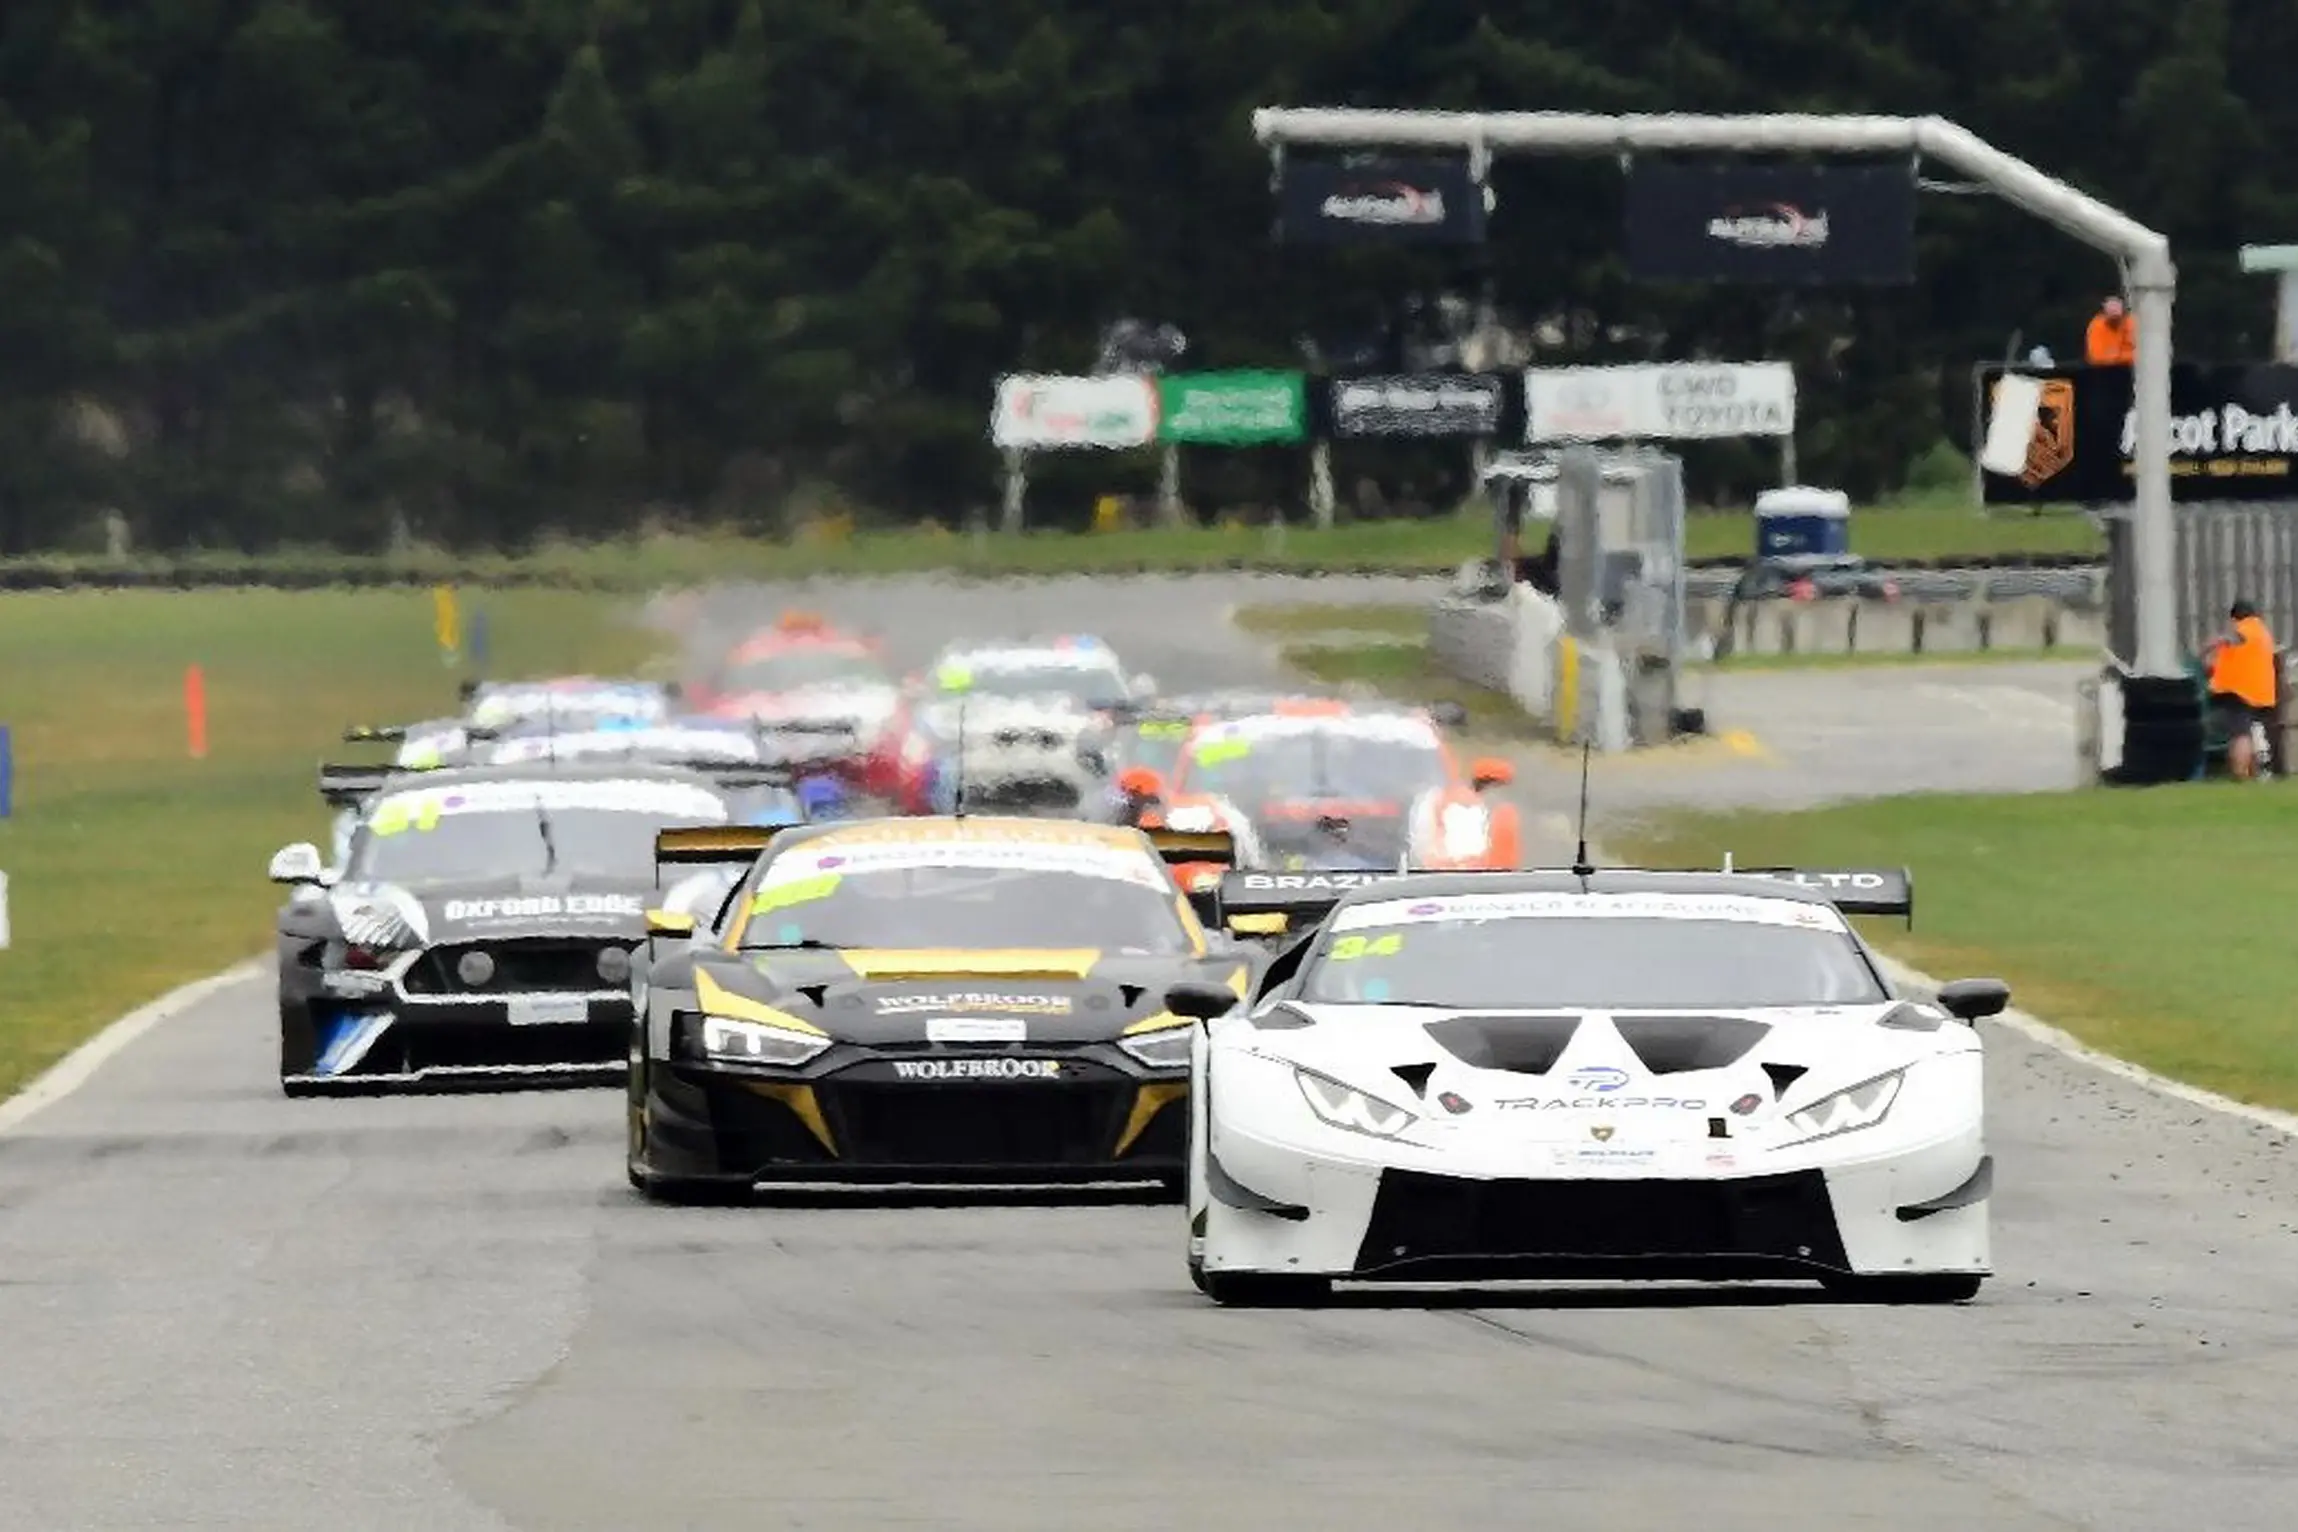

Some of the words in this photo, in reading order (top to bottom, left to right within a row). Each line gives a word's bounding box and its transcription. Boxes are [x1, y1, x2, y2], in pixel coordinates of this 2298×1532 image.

[1794, 873, 1883, 889] LTD
[444, 896, 561, 921] OXFORD
[892, 1059, 1060, 1080] WOLFBROOK
[1493, 1097, 1707, 1111] TRACKPRO
